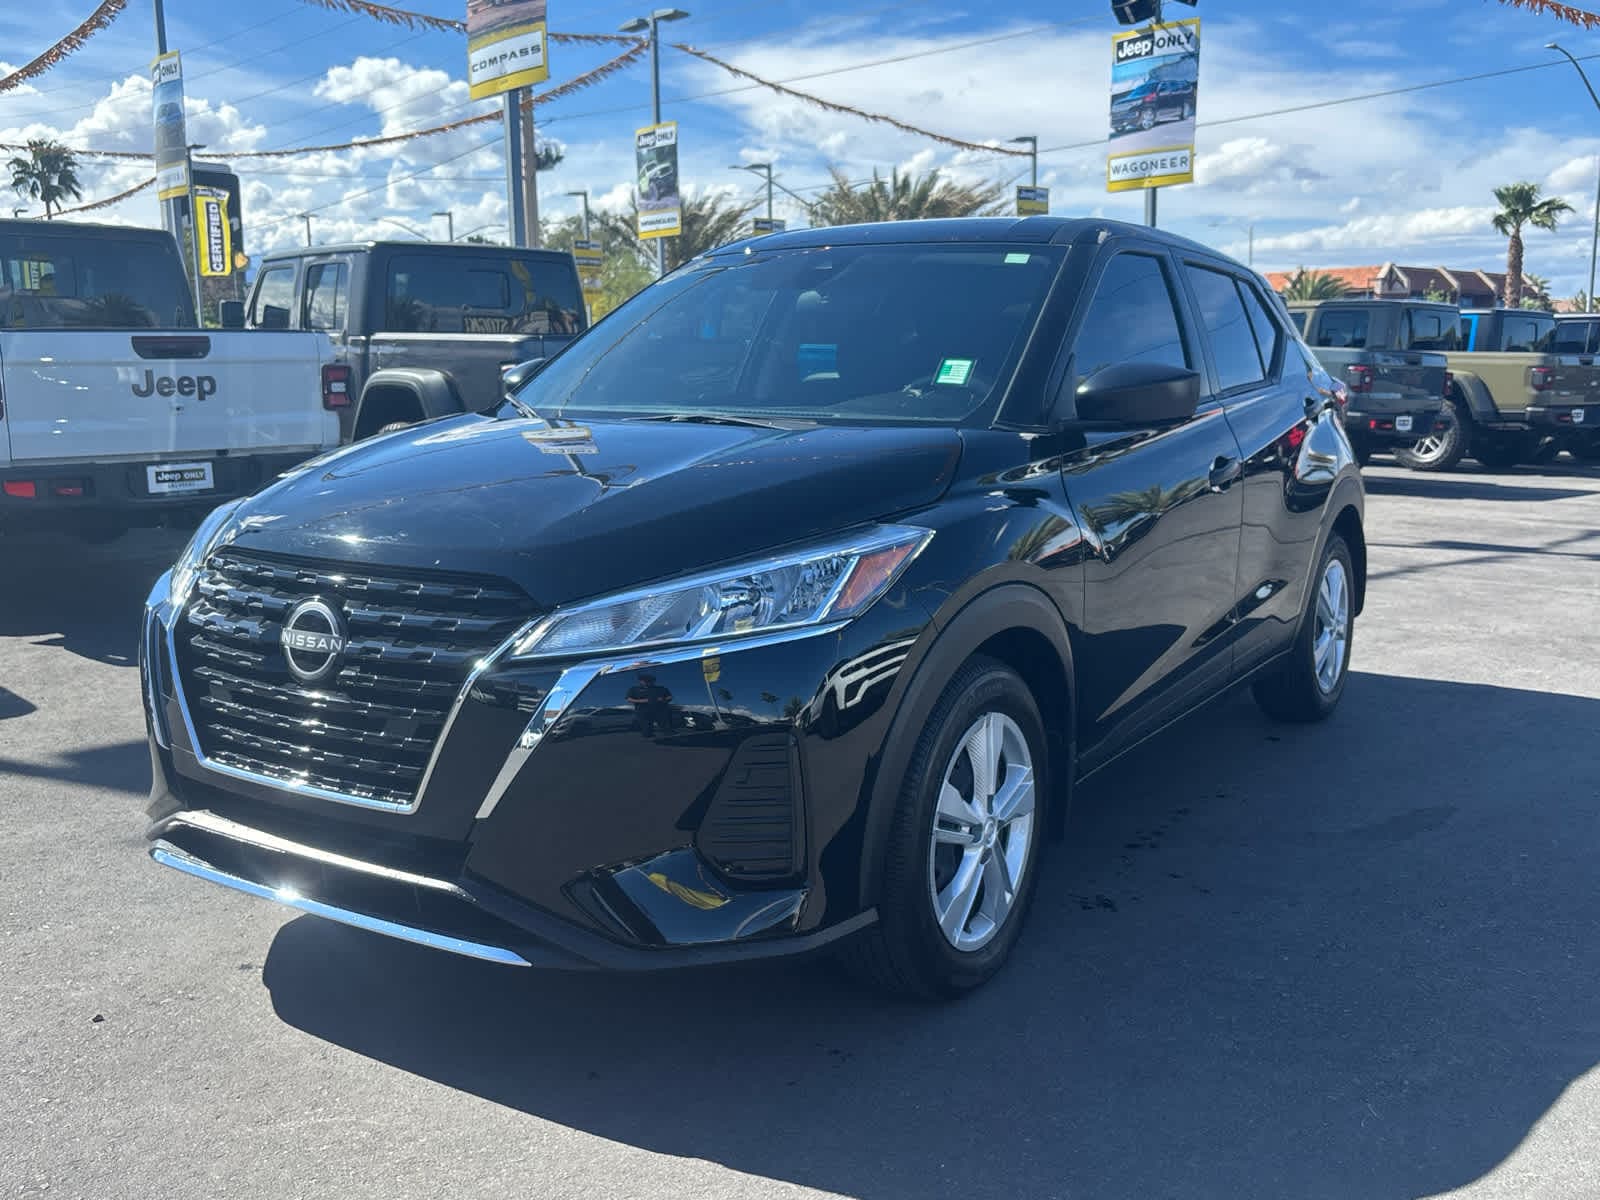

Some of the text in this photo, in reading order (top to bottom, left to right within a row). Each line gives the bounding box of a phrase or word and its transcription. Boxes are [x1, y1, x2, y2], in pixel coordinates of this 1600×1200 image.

[1118, 31, 1193, 58] Jeep ONLY
[472, 44, 541, 73] COMPASS
[1111, 155, 1189, 176] WAGONEER
[208, 203, 224, 273] CERTIFIED
[131, 368, 217, 401] Jeep
[157, 471, 182, 481] Jeep
[281, 628, 343, 651] NISSAN
